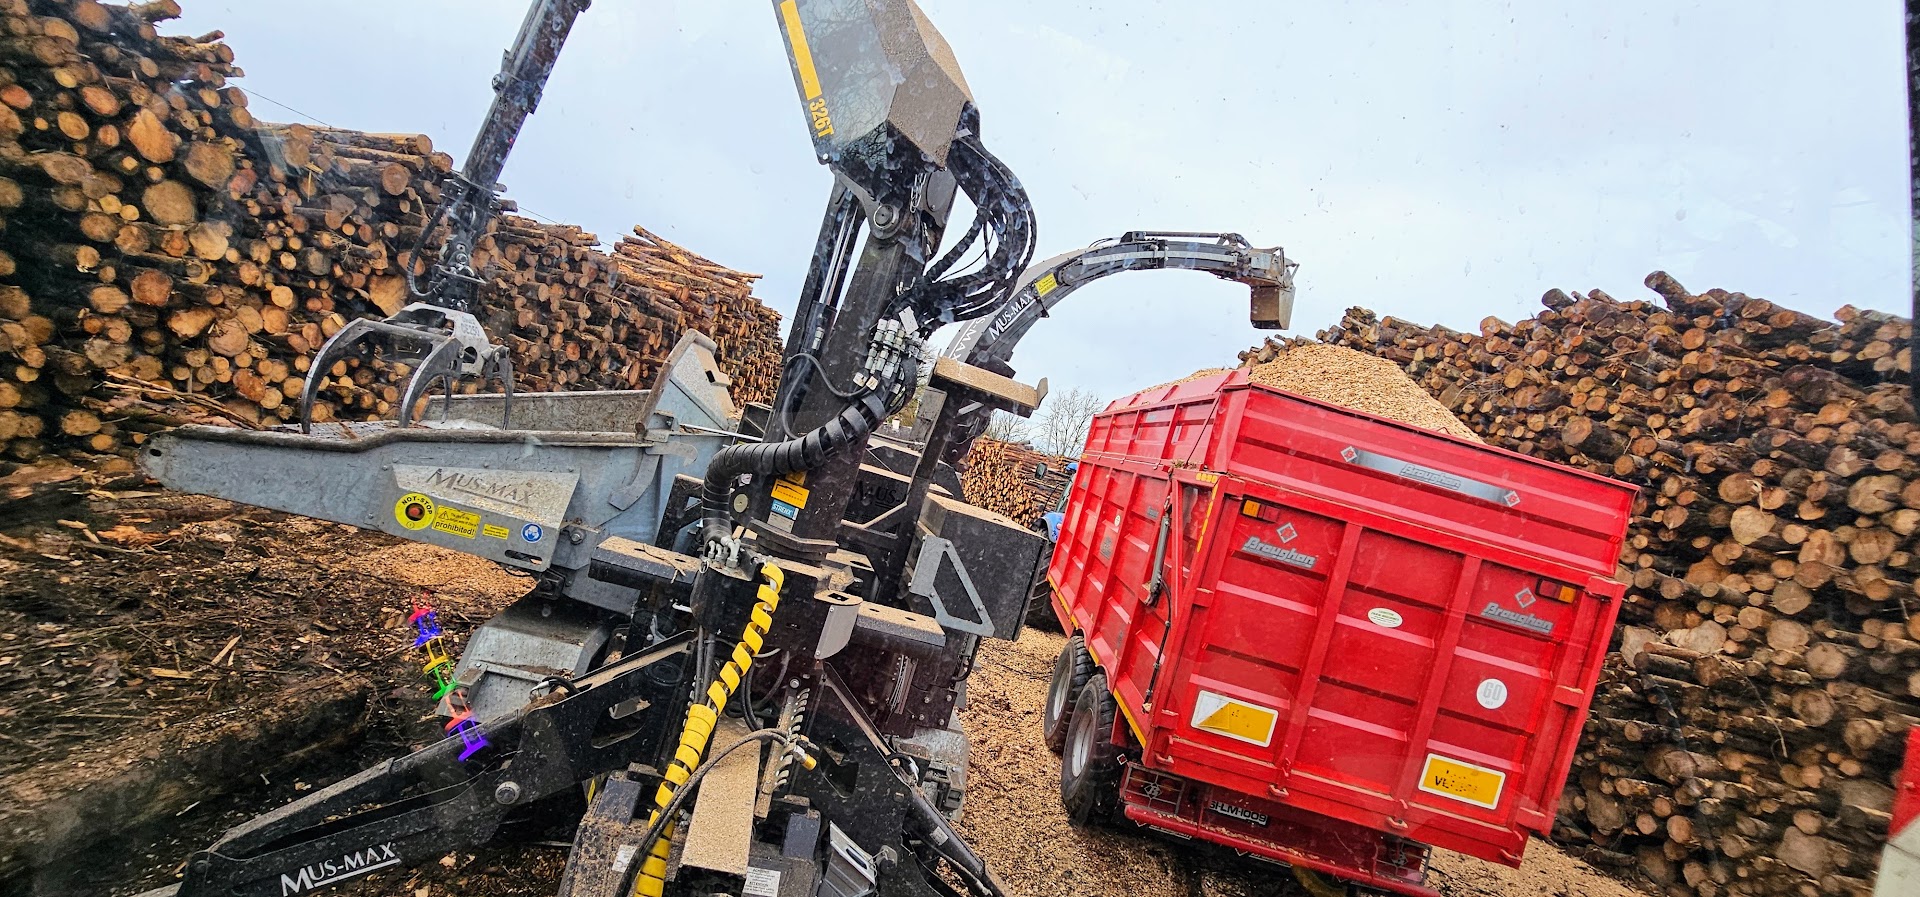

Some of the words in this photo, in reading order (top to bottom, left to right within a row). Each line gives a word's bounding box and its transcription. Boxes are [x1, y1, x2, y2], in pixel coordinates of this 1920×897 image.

[810, 98, 834, 138] 326T
[988, 291, 1034, 341] MUS-MAX
[425, 468, 535, 504] MUS-MAX
[1400, 463, 1461, 490] Broughan
[402, 495, 433, 515] NOT-STOP
[435, 521, 475, 536] prohibited!
[1242, 536, 1317, 568] Broughan
[1481, 601, 1554, 633] Broughan
[1483, 681, 1503, 701] 60
[280, 841, 396, 897] MUS-MAX
